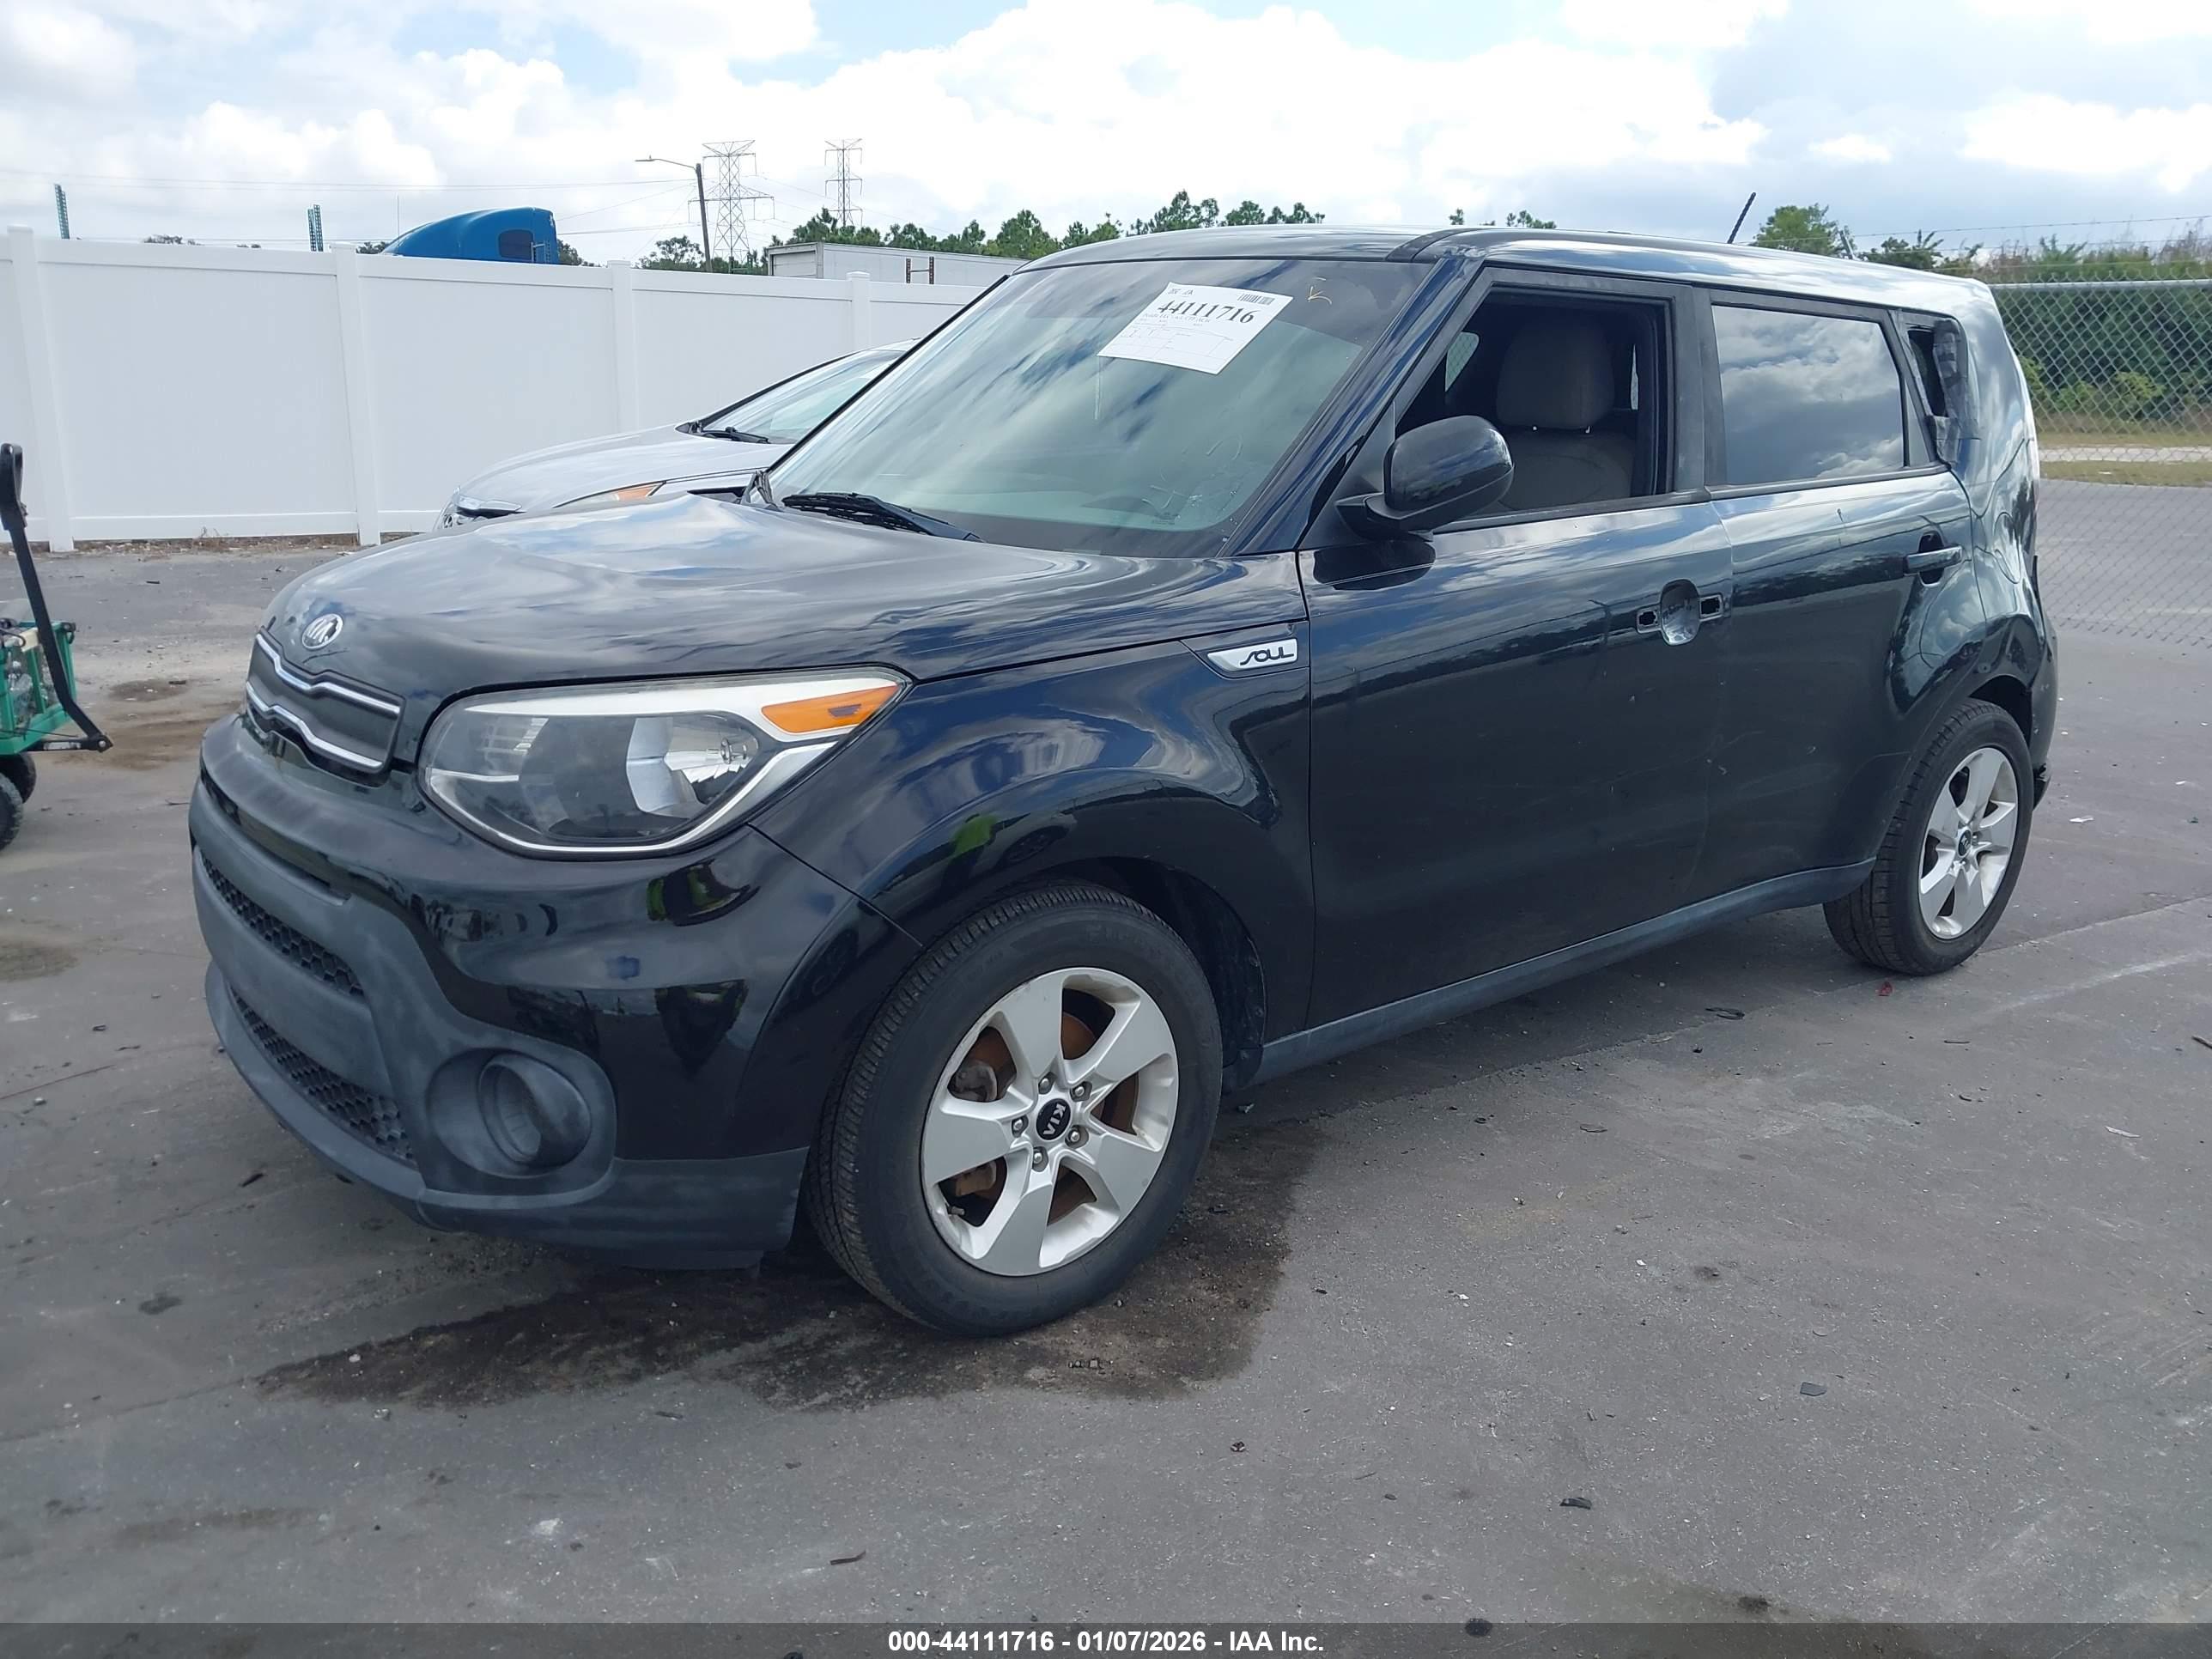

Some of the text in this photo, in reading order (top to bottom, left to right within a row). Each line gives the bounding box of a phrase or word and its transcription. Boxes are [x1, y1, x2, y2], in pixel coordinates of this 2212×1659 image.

[1158, 300, 1257, 324] 44111716
[1240, 647, 1295, 666] SOUL
[1042, 1103, 1066, 1135] KIA
